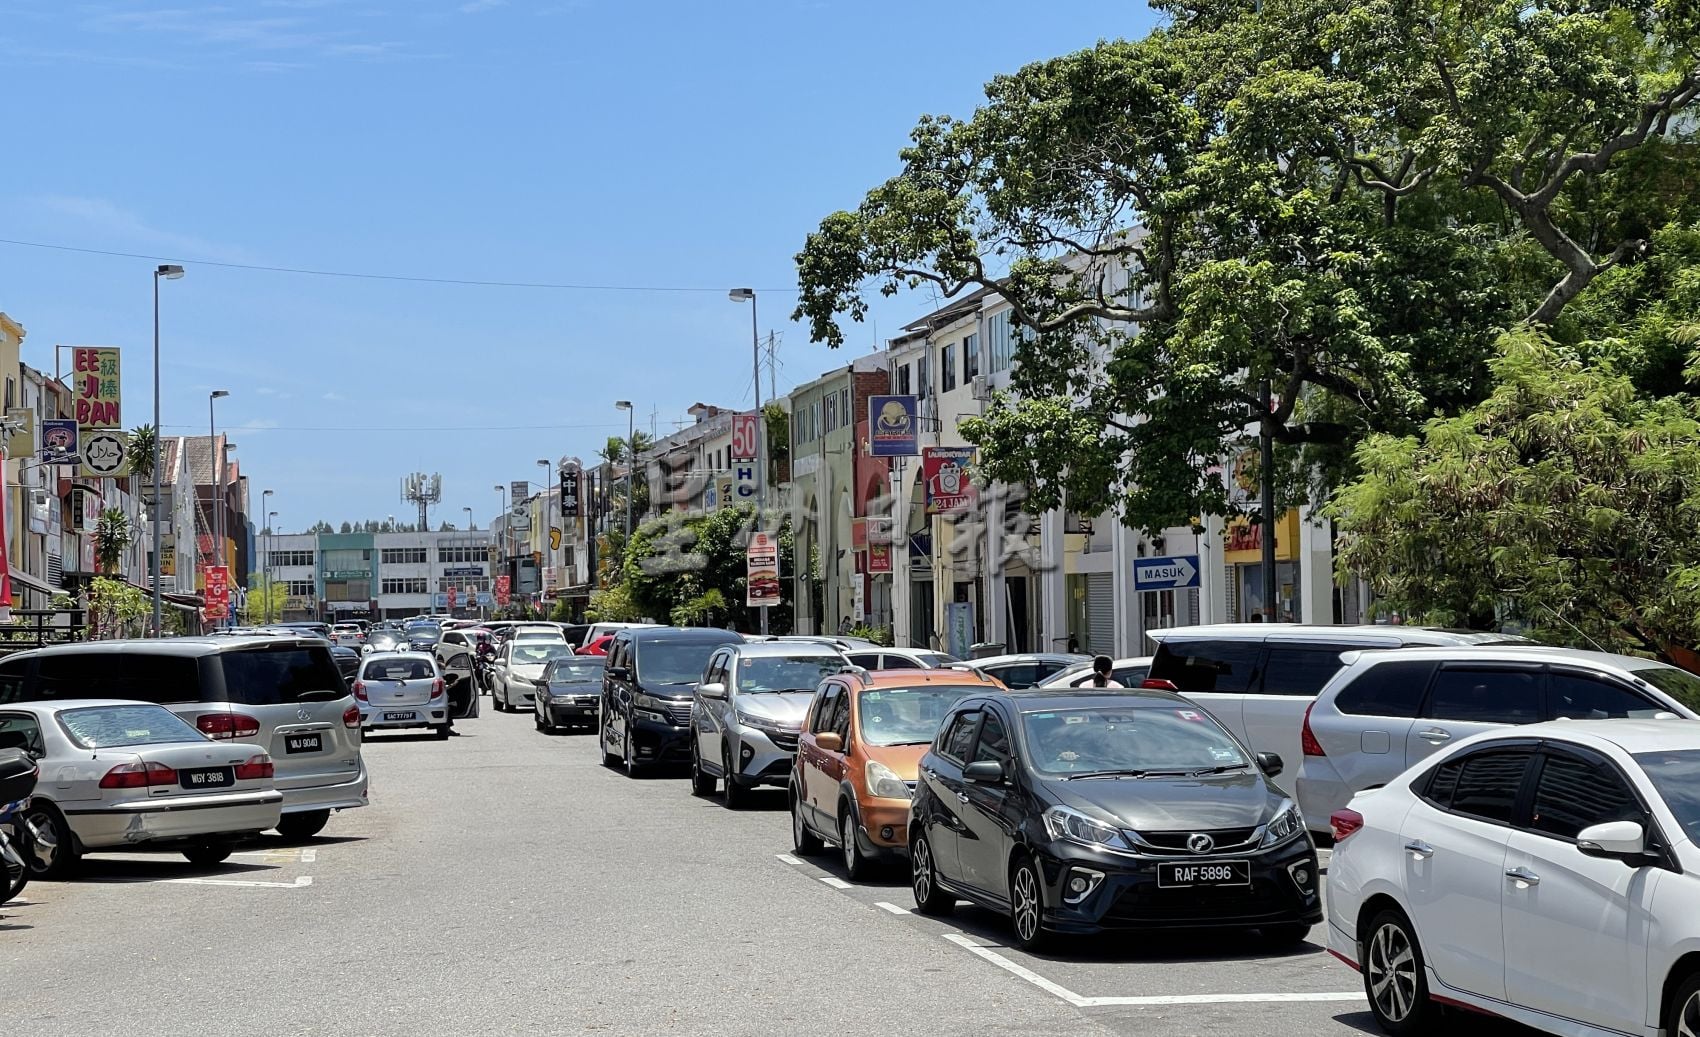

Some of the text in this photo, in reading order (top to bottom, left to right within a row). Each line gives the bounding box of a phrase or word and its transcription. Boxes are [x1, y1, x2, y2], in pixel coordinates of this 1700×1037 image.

[75, 349, 100, 372] EE
[76, 399, 119, 425] BAN
[733, 417, 756, 455] 50
[948, 498, 968, 508] JAM
[1144, 567, 1185, 579] MASUK
[213, 584, 222, 596] 6
[191, 772, 224, 784] WGY 3818
[1174, 866, 1232, 882] RAF 5896
